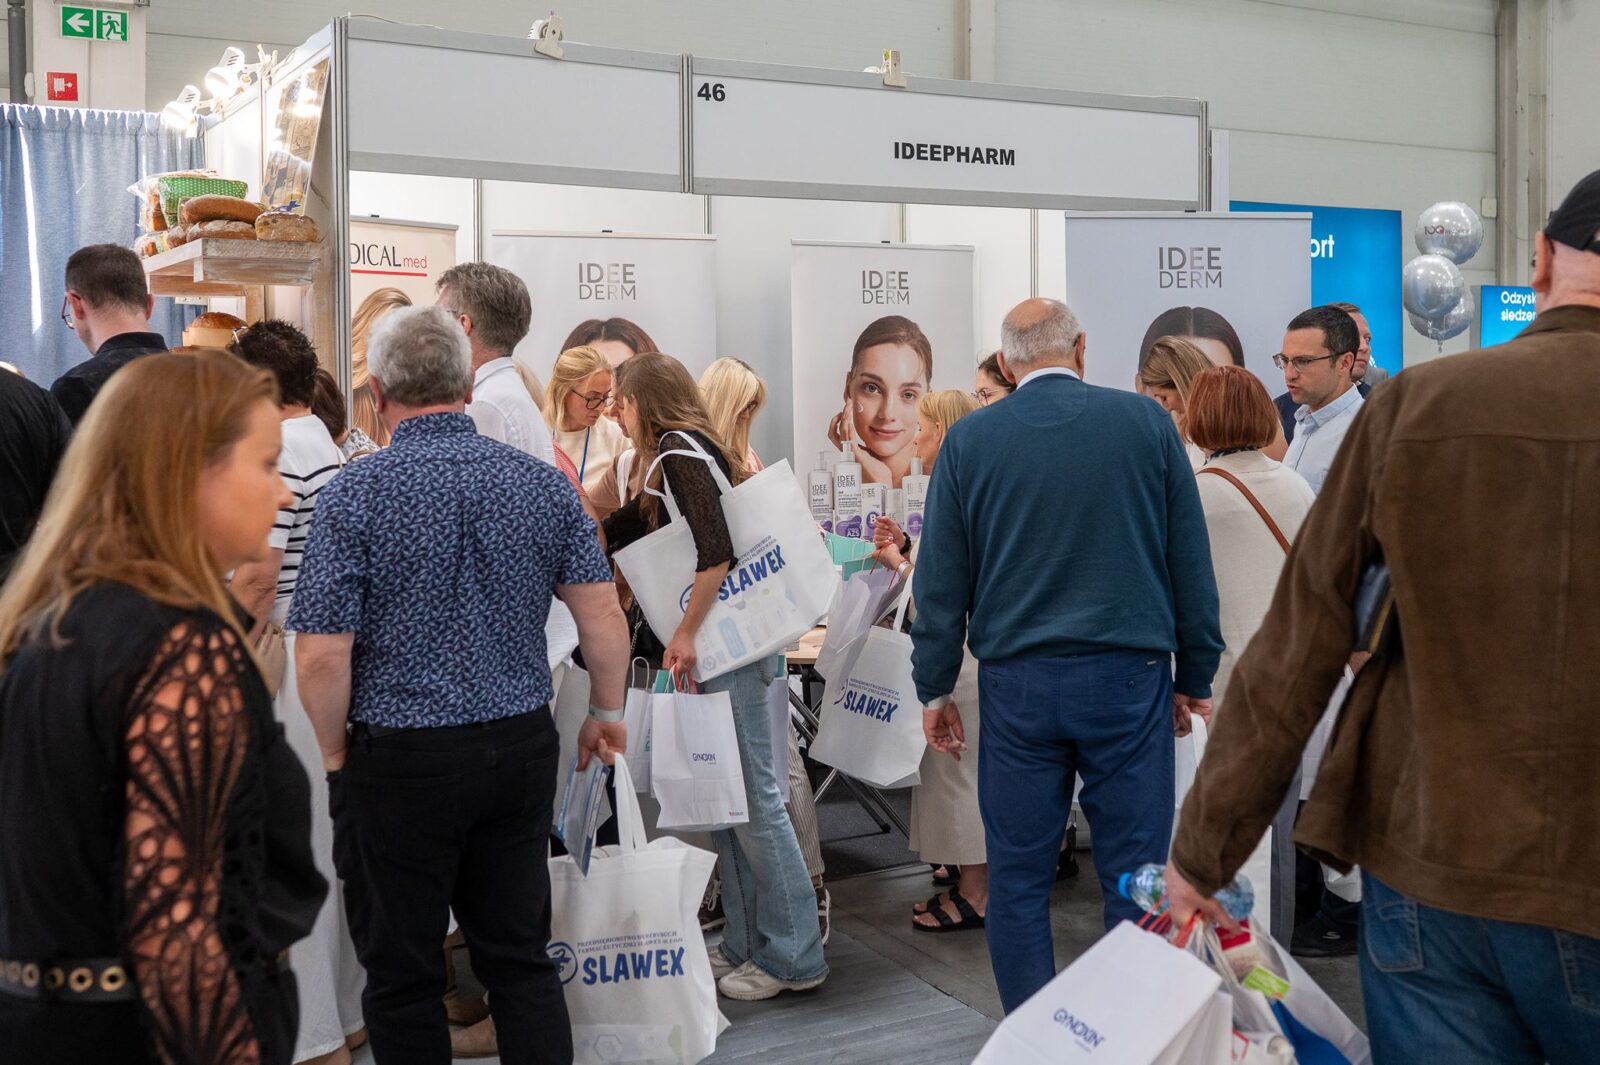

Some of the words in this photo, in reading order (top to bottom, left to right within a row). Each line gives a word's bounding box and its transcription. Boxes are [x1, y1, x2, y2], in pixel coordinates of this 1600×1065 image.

[697, 82, 726, 102] 46
[893, 141, 1015, 166] IDEEPHARM
[1159, 247, 1222, 270] IDEE
[578, 262, 636, 284] IDEE
[862, 270, 909, 290] IDEE
[1159, 271, 1222, 289] DERM
[579, 284, 636, 300] DERM
[862, 290, 910, 305] DERM
[846, 529, 861, 537] AZS
[718, 544, 786, 601] SLAWEX
[843, 690, 898, 723] SLAWEX
[582, 946, 685, 986] SLAWEX
